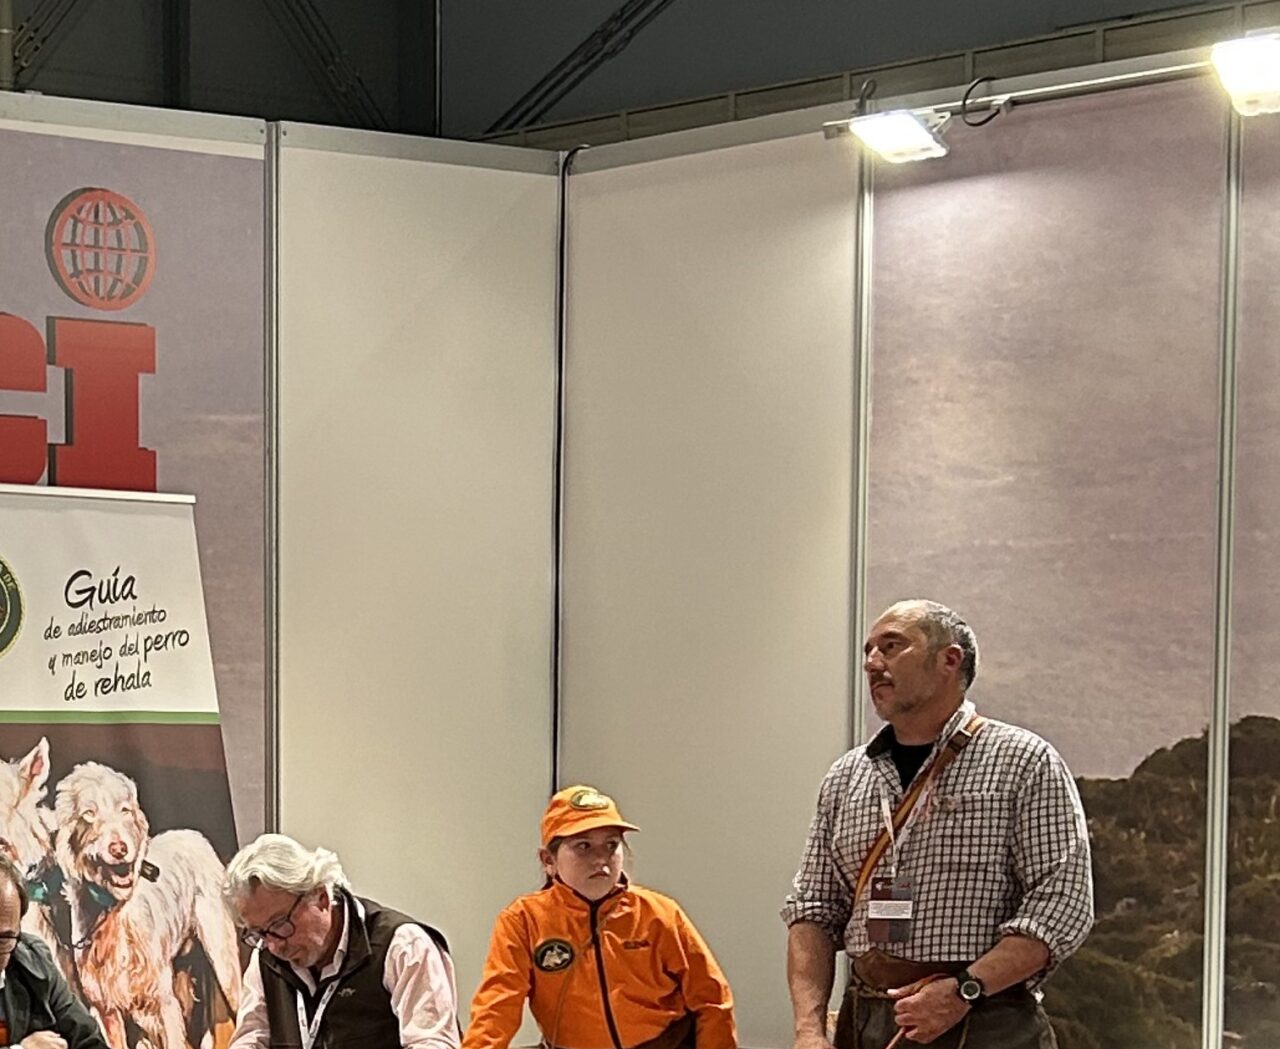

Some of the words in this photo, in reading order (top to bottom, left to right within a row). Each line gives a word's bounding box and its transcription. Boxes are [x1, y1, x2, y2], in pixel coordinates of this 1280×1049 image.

[64, 565, 138, 611] Guía
[43, 615, 63, 641] de
[67, 603, 168, 637] adiestramiento
[47, 653, 57, 677] y
[61, 639, 113, 670] manejo
[118, 631, 140, 658] del
[143, 628, 190, 663] perro
[63, 669, 88, 701] de
[94, 657, 153, 698] rehala
